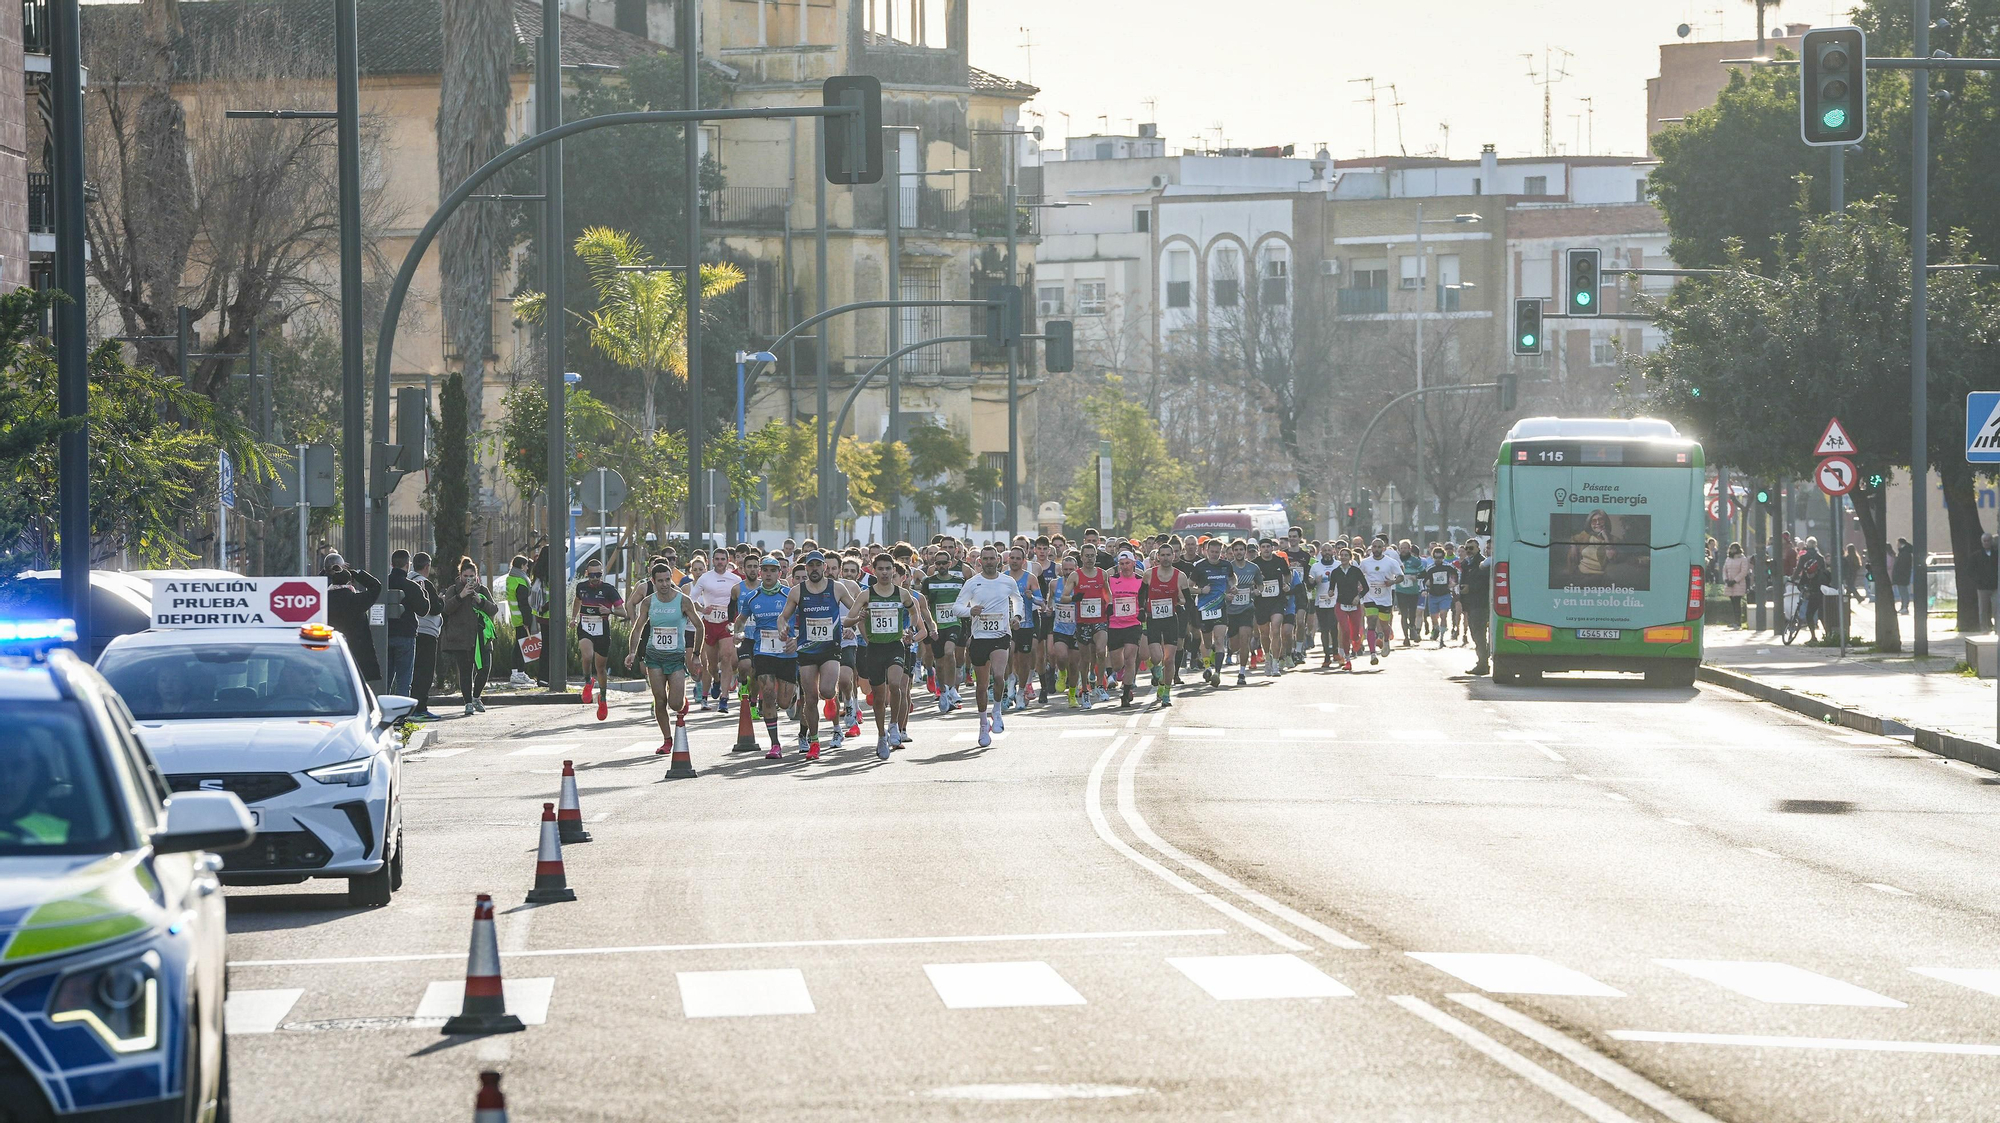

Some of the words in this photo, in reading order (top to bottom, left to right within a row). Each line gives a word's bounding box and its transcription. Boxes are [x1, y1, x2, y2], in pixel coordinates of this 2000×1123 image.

[1539, 451, 1563, 461] 115
[1582, 482, 1612, 491] Pásate
[1568, 493, 1600, 503] Gana
[1602, 494, 1647, 506] Energía
[165, 580, 257, 593] ATENCIÓN
[1564, 583, 1581, 594] sin
[1583, 583, 1635, 596] papeleos
[173, 598, 249, 608] PRUEBA
[273, 595, 317, 609] STOP
[1553, 598, 1561, 608] y
[1563, 598, 1577, 606] en
[1580, 598, 1595, 606] un
[1597, 596, 1620, 607] solo
[1622, 596, 1644, 607] día.
[803, 605, 830, 613] enerplus
[1086, 605, 1096, 613] 49
[1121, 604, 1131, 612] 43
[1155, 605, 1169, 614] 240
[157, 613, 264, 625] DEPORTIVA
[713, 611, 726, 620] 176
[940, 610, 954, 619] 204
[587, 623, 596, 631] 57
[876, 617, 893, 628] 351
[983, 621, 999, 631] 323
[811, 626, 828, 636] 479
[1581, 630, 1600, 638] 4545
[1603, 630, 1618, 638] KST
[657, 635, 672, 645] 203
[523, 641, 542, 654] STOP
